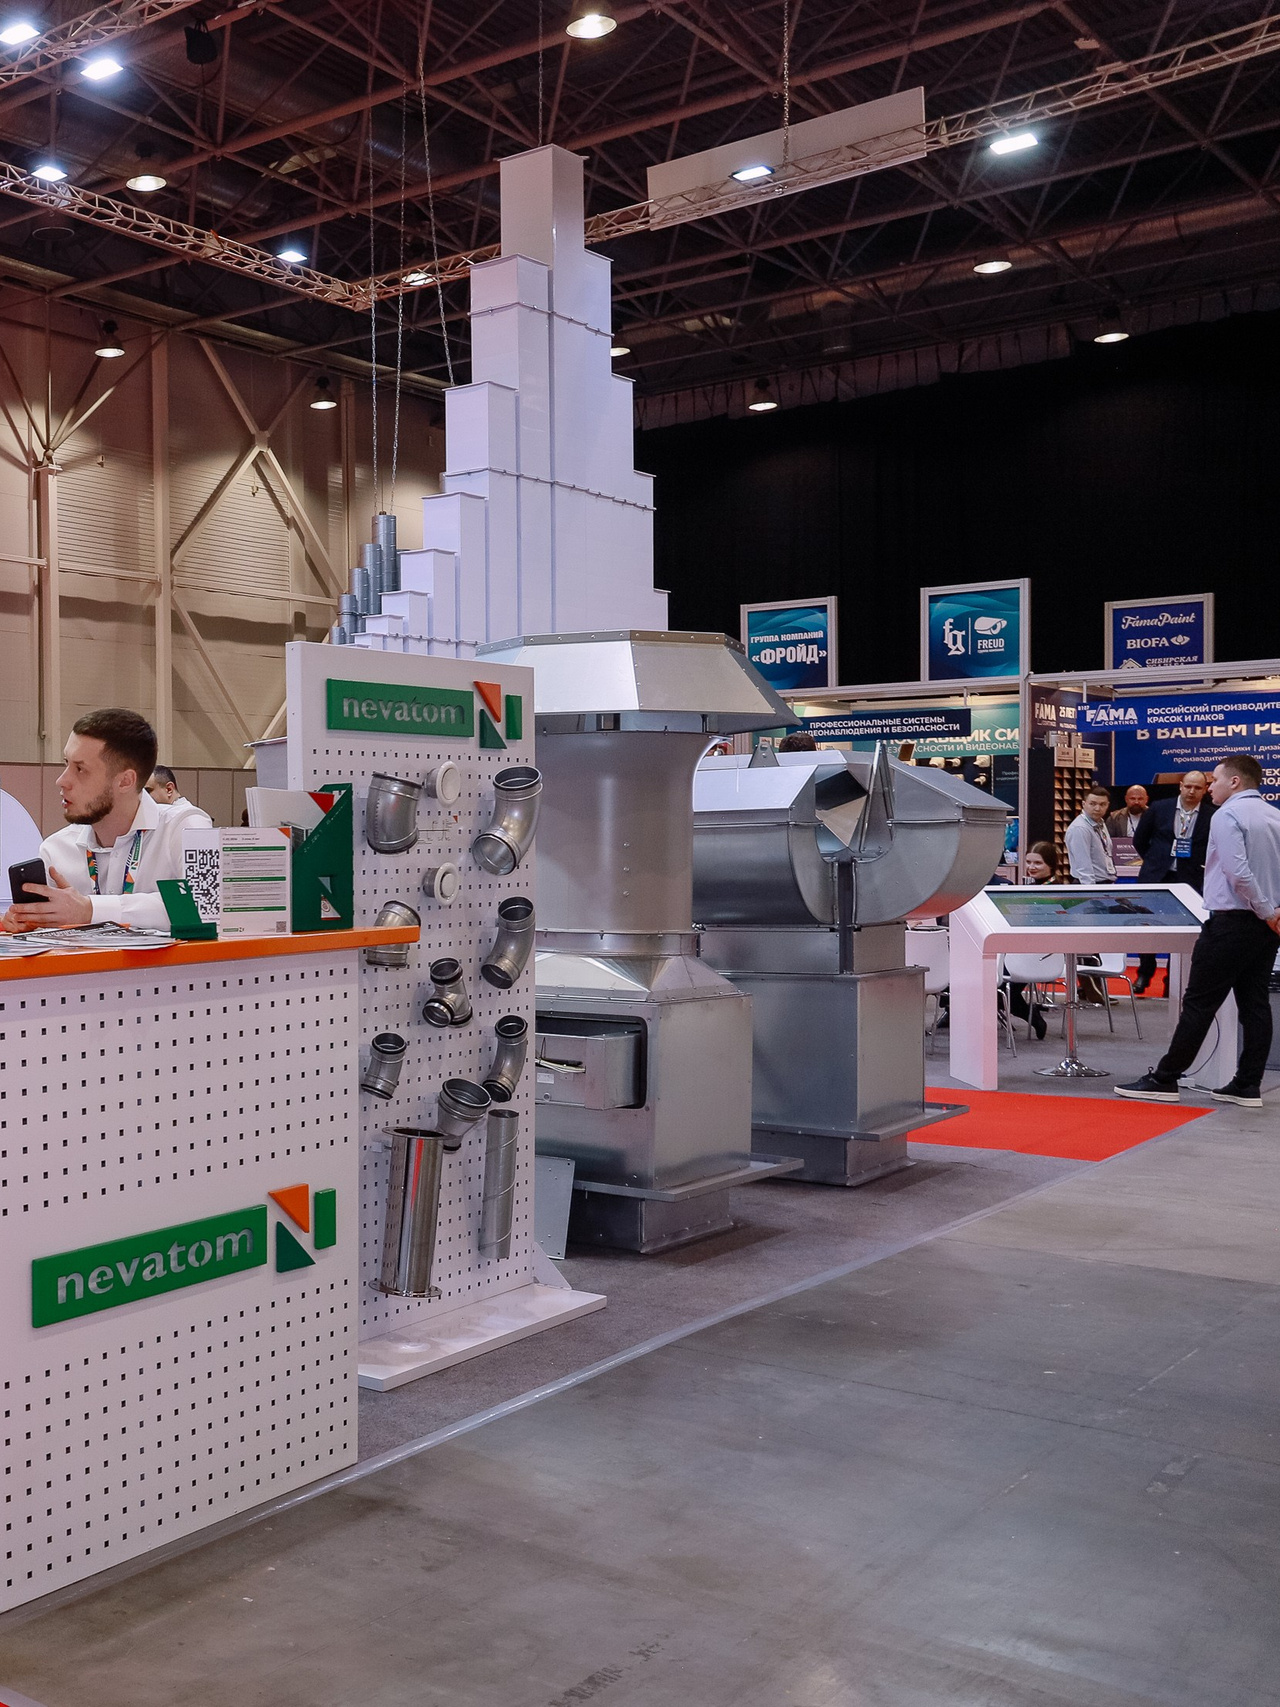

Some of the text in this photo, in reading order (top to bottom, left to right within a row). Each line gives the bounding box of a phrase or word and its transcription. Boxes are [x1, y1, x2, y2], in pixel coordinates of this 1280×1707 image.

[750, 630, 824, 643] ГРУППА КОМПАНИЙ
[1126, 637, 1170, 649] BIOFA
[977, 638, 1005, 649] FREUD
[751, 643, 827, 664] «ФРОЙД»
[1145, 656, 1198, 665] СИБИРСКАЯ
[342, 696, 465, 724] nevatom
[1034, 702, 1056, 721] FAMA
[1086, 706, 1138, 723] FAMA
[1147, 703, 1209, 715] РОССИЙСКИЙ
[810, 716, 945, 729] ПРОФЕССИОНАЛЬНЫЕ СИСТЕМЫ
[1147, 715, 1183, 724] КРАСОК
[1193, 713, 1224, 722] ЛАКОВ
[891, 724, 960, 733] БЕЗОПАСНОСТИ
[1157, 724, 1248, 740] ВАШЕМ
[956, 744, 964, 752] И
[965, 742, 1019, 751] ВИДЕОНАБ
[57, 1228, 253, 1304] nevatom
